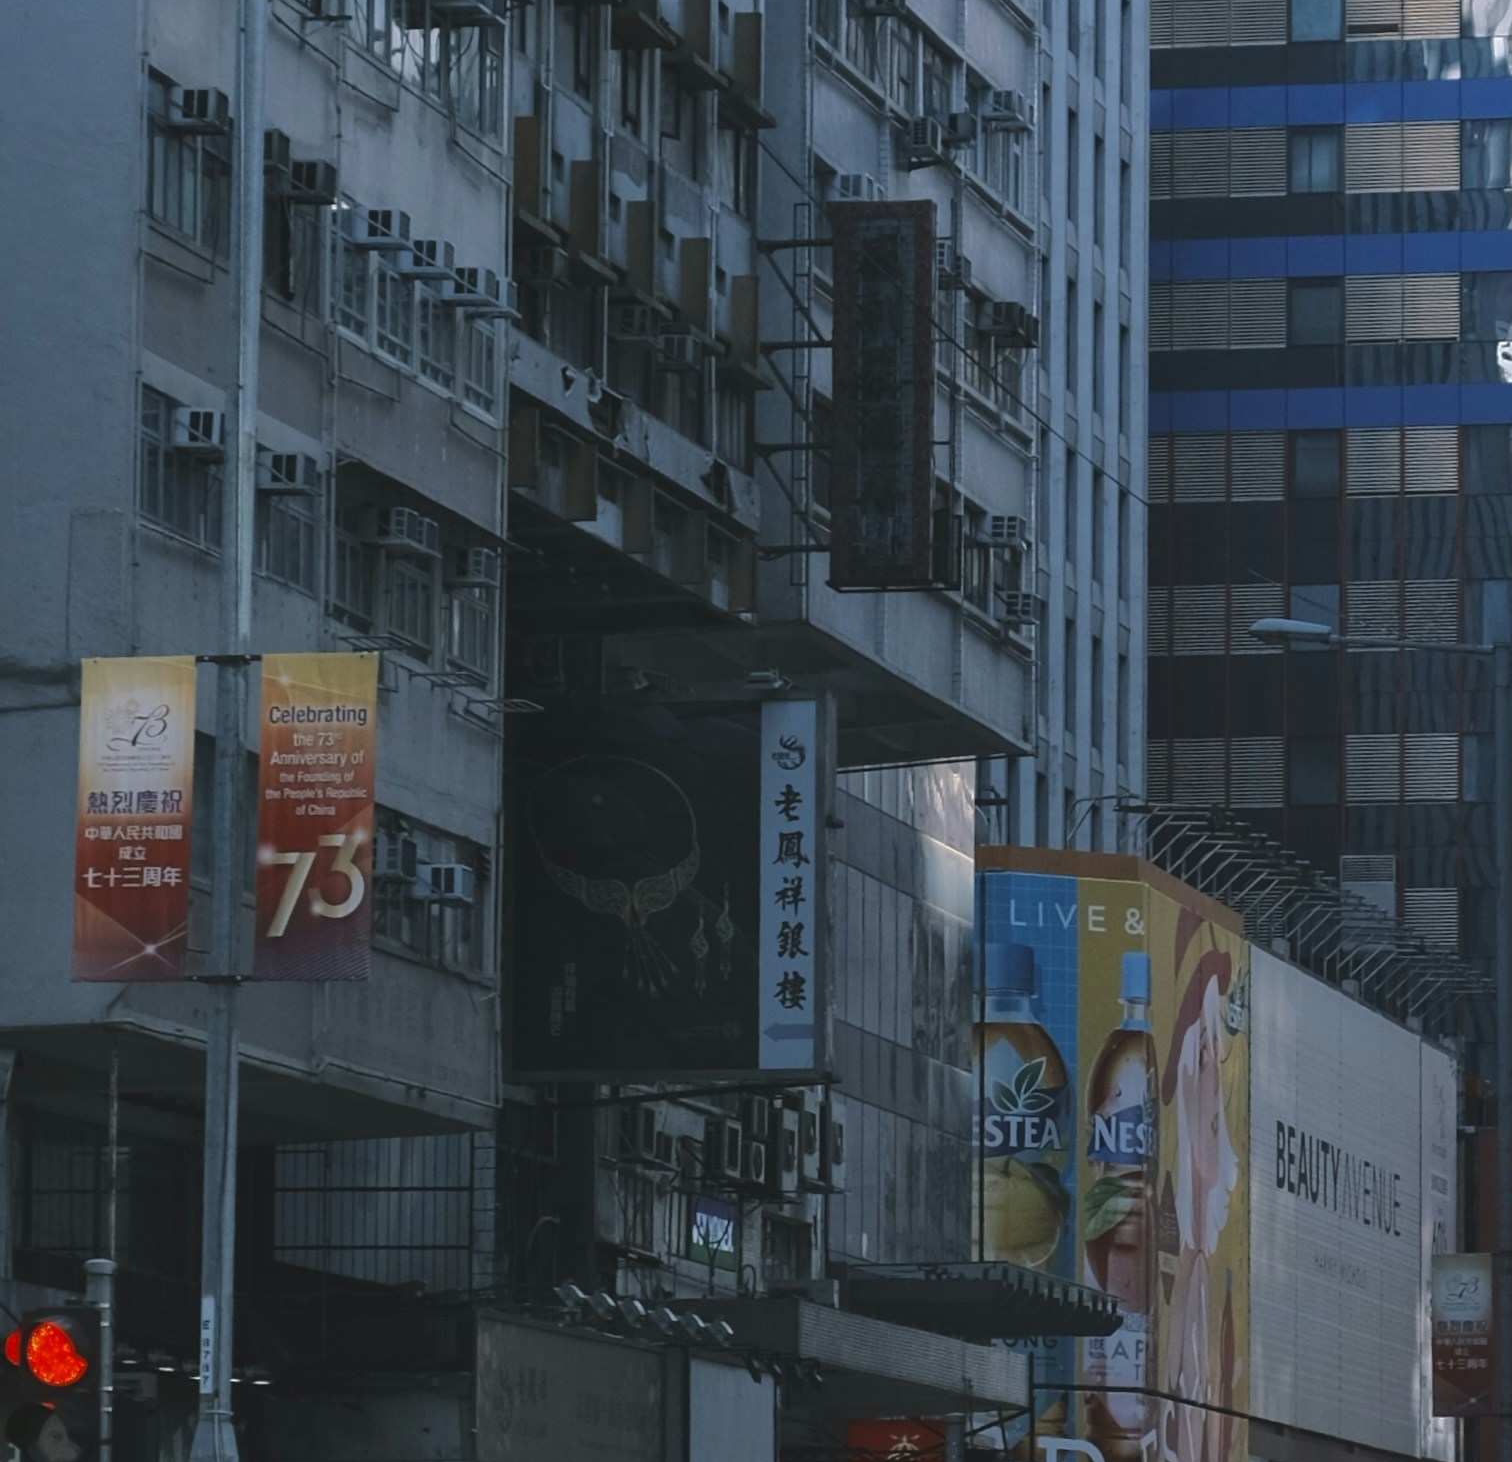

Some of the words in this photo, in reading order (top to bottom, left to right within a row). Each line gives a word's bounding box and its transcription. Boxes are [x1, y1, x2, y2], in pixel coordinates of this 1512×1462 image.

[269, 705, 367, 727] Celebrating
[293, 732, 314, 747] the
[270, 750, 347, 768] Anniversary
[351, 749, 365, 764] of
[279, 772, 295, 783] the
[297, 770, 342, 784] Founding
[344, 770, 355, 782] of
[87, 790, 183, 815] 熱烈慶祝
[265, 788, 281, 800] the
[283, 787, 324, 801] People's
[325, 787, 368, 799] Republic
[295, 804, 307, 816] of
[308, 804, 336, 816] China
[84, 824, 183, 841] 中華人民共和國
[118, 845, 147, 861] 成立
[82, 866, 183, 889] 七十三周年
[266, 832, 367, 938] 73
[773, 783, 811, 1012] 老鳳祥銀樓
[1009, 898, 1106, 933] LIVE
[1124, 907, 1145, 936] &
